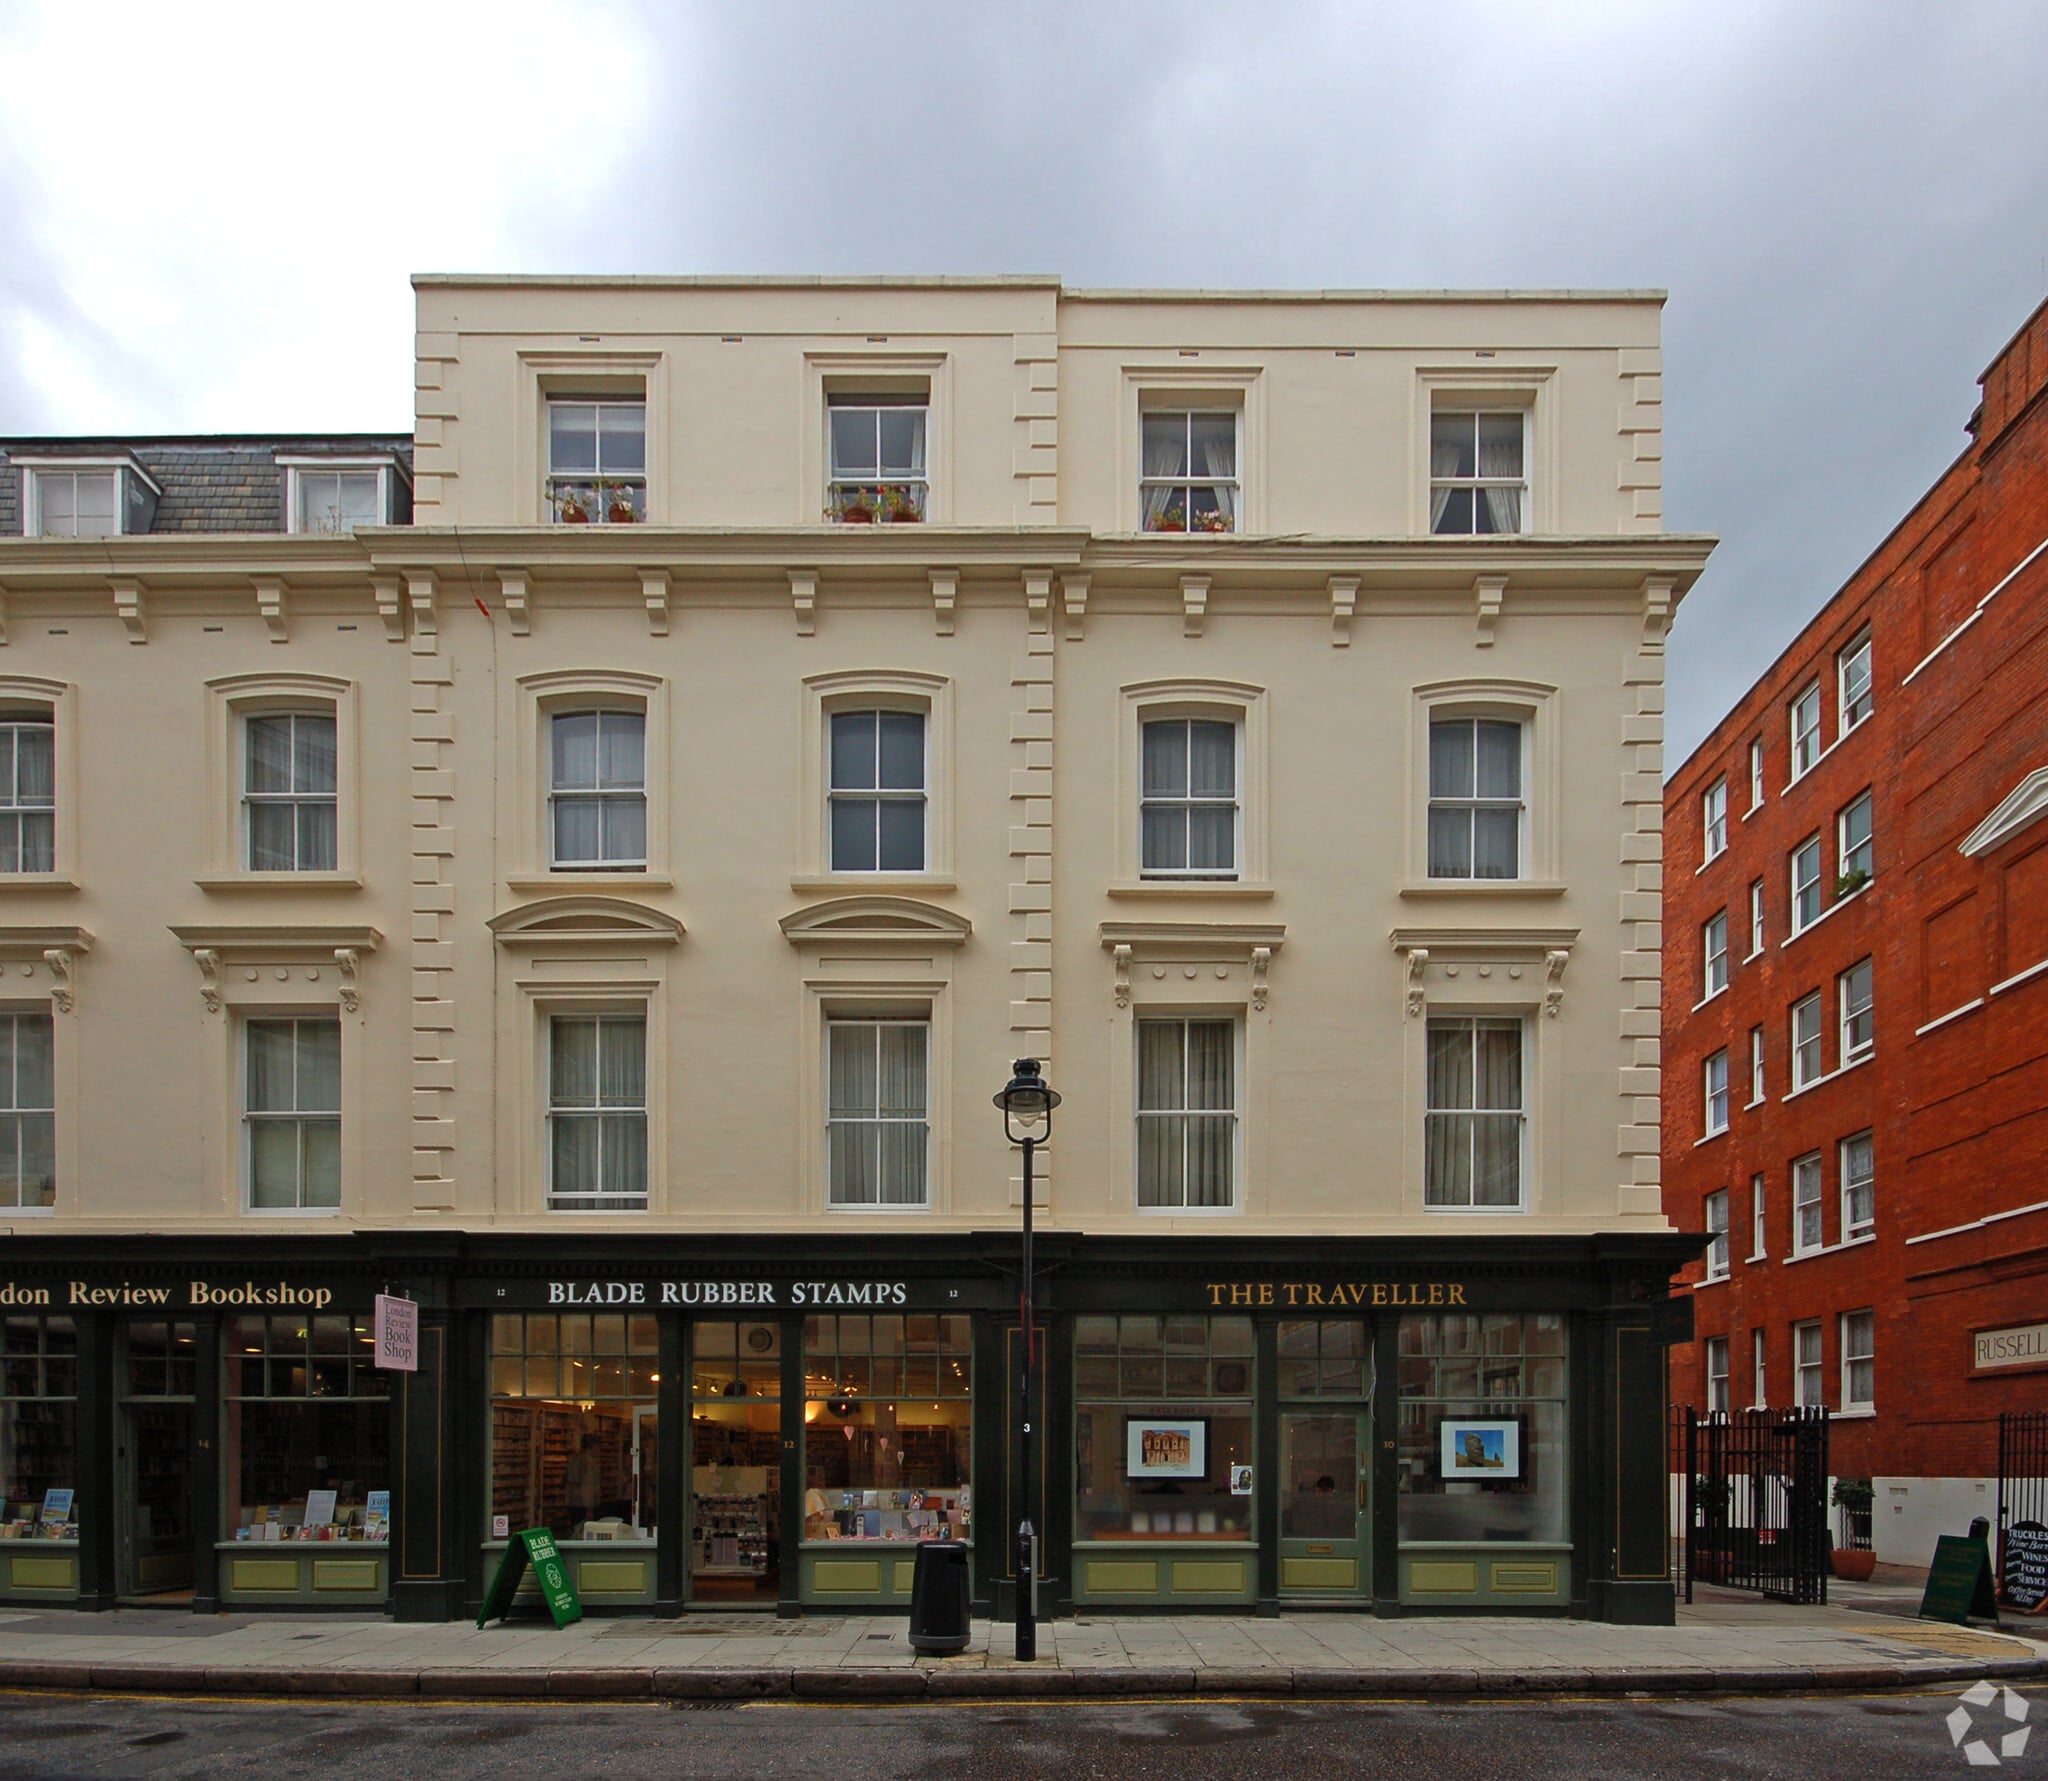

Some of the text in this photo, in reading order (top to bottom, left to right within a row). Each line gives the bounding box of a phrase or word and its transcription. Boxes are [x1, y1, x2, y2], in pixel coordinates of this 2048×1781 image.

[68, 1281, 171, 1305] Review
[189, 1281, 332, 1309] Bookshop
[497, 1289, 506, 1297] 12
[548, 1282, 907, 1304] BLADE RUBBER STAMPS
[949, 1289, 959, 1298] 12
[1207, 1283, 1468, 1305] THE TRAVELLER
[385, 1303, 412, 1319] London
[385, 1315, 411, 1328] Review
[385, 1326, 411, 1344] Book
[384, 1341, 412, 1363] Shop
[1977, 1332, 2047, 1361] RUSSELL
[1023, 1423, 1031, 1433] 3
[784, 1440, 795, 1449] 12
[1384, 1440, 1395, 1449] 10
[2009, 1529, 2048, 1541] TRUCKLES
[529, 1536, 550, 1549] BLADE
[532, 1547, 556, 1561] RUBBER
[2021, 1563, 2045, 1575] FOOD
